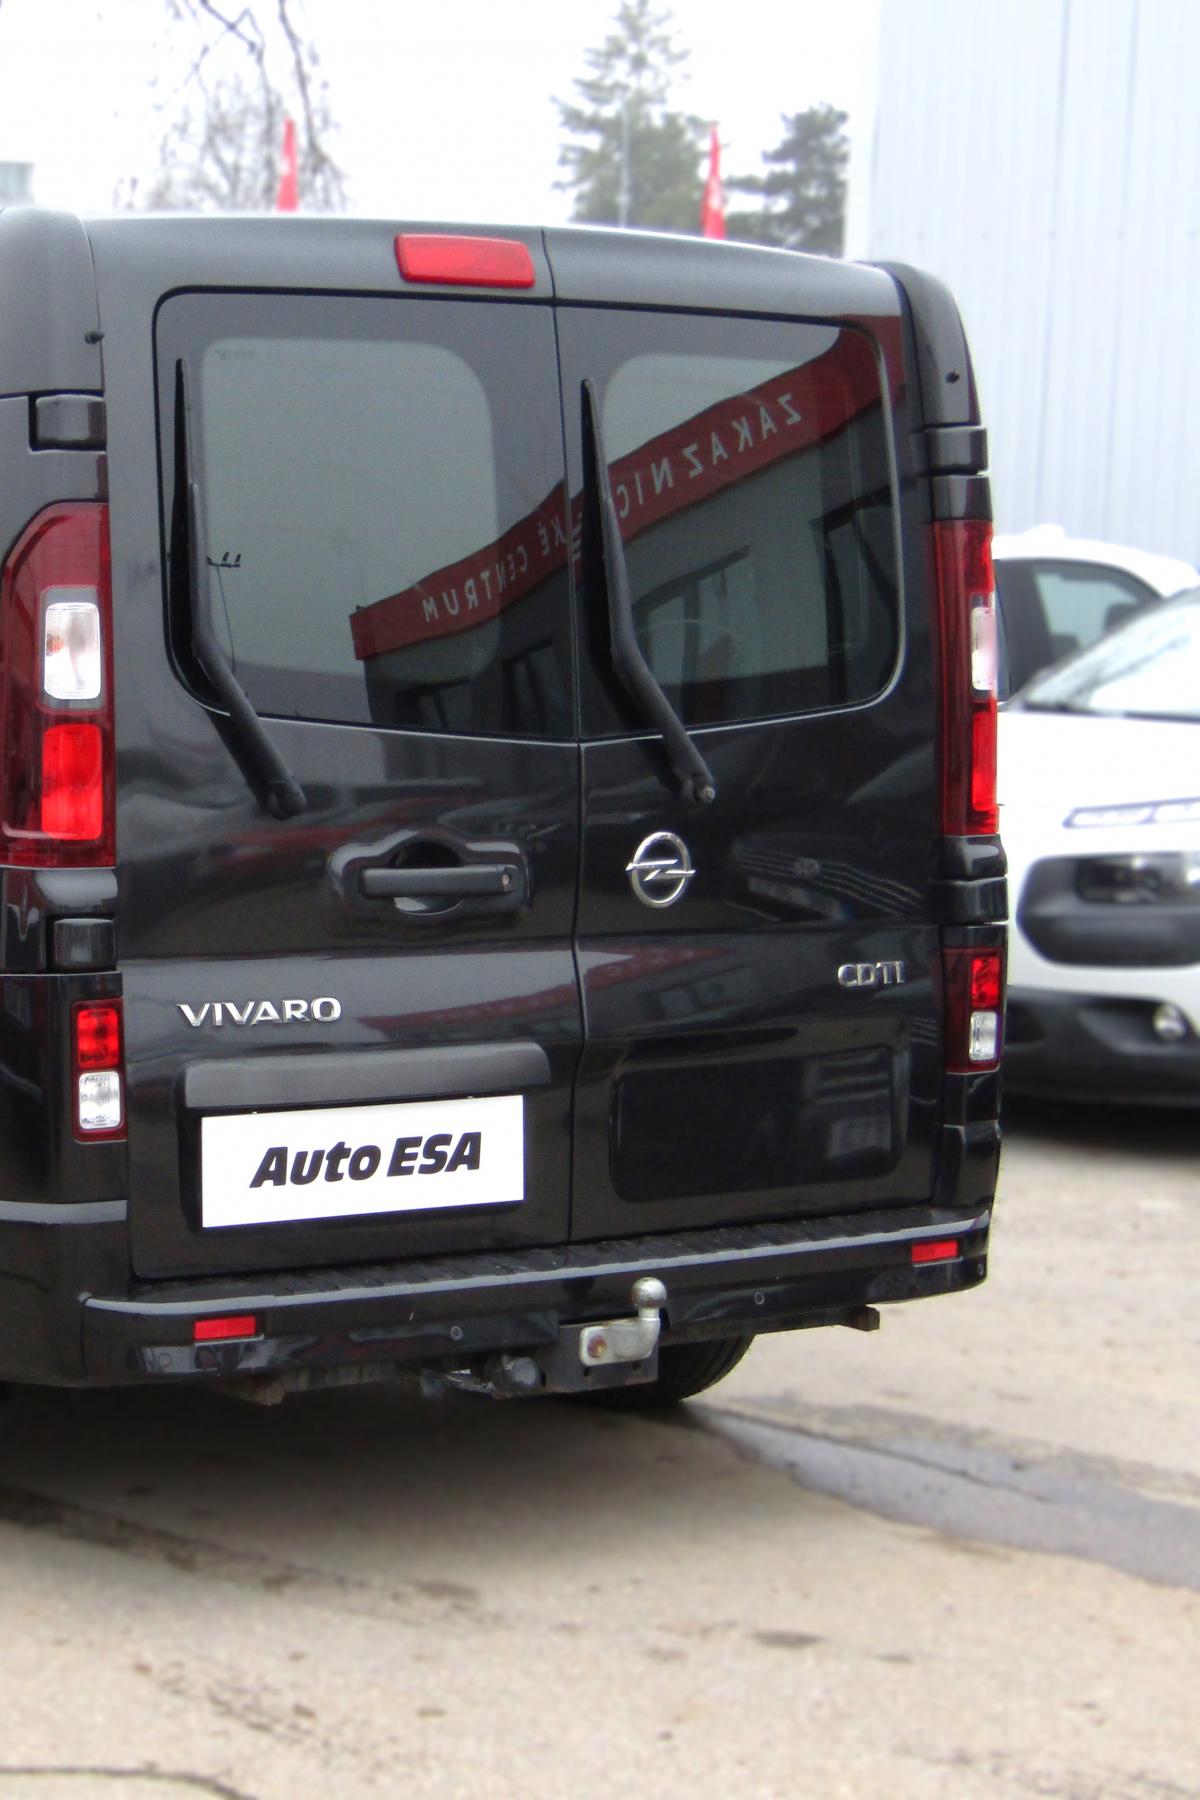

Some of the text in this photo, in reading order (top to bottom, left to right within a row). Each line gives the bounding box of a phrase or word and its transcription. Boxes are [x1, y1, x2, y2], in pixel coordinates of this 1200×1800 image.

[837, 961, 904, 987] CDTI
[177, 997, 341, 1027] VIVARO
[249, 1132, 481, 1188] Auto ESA
